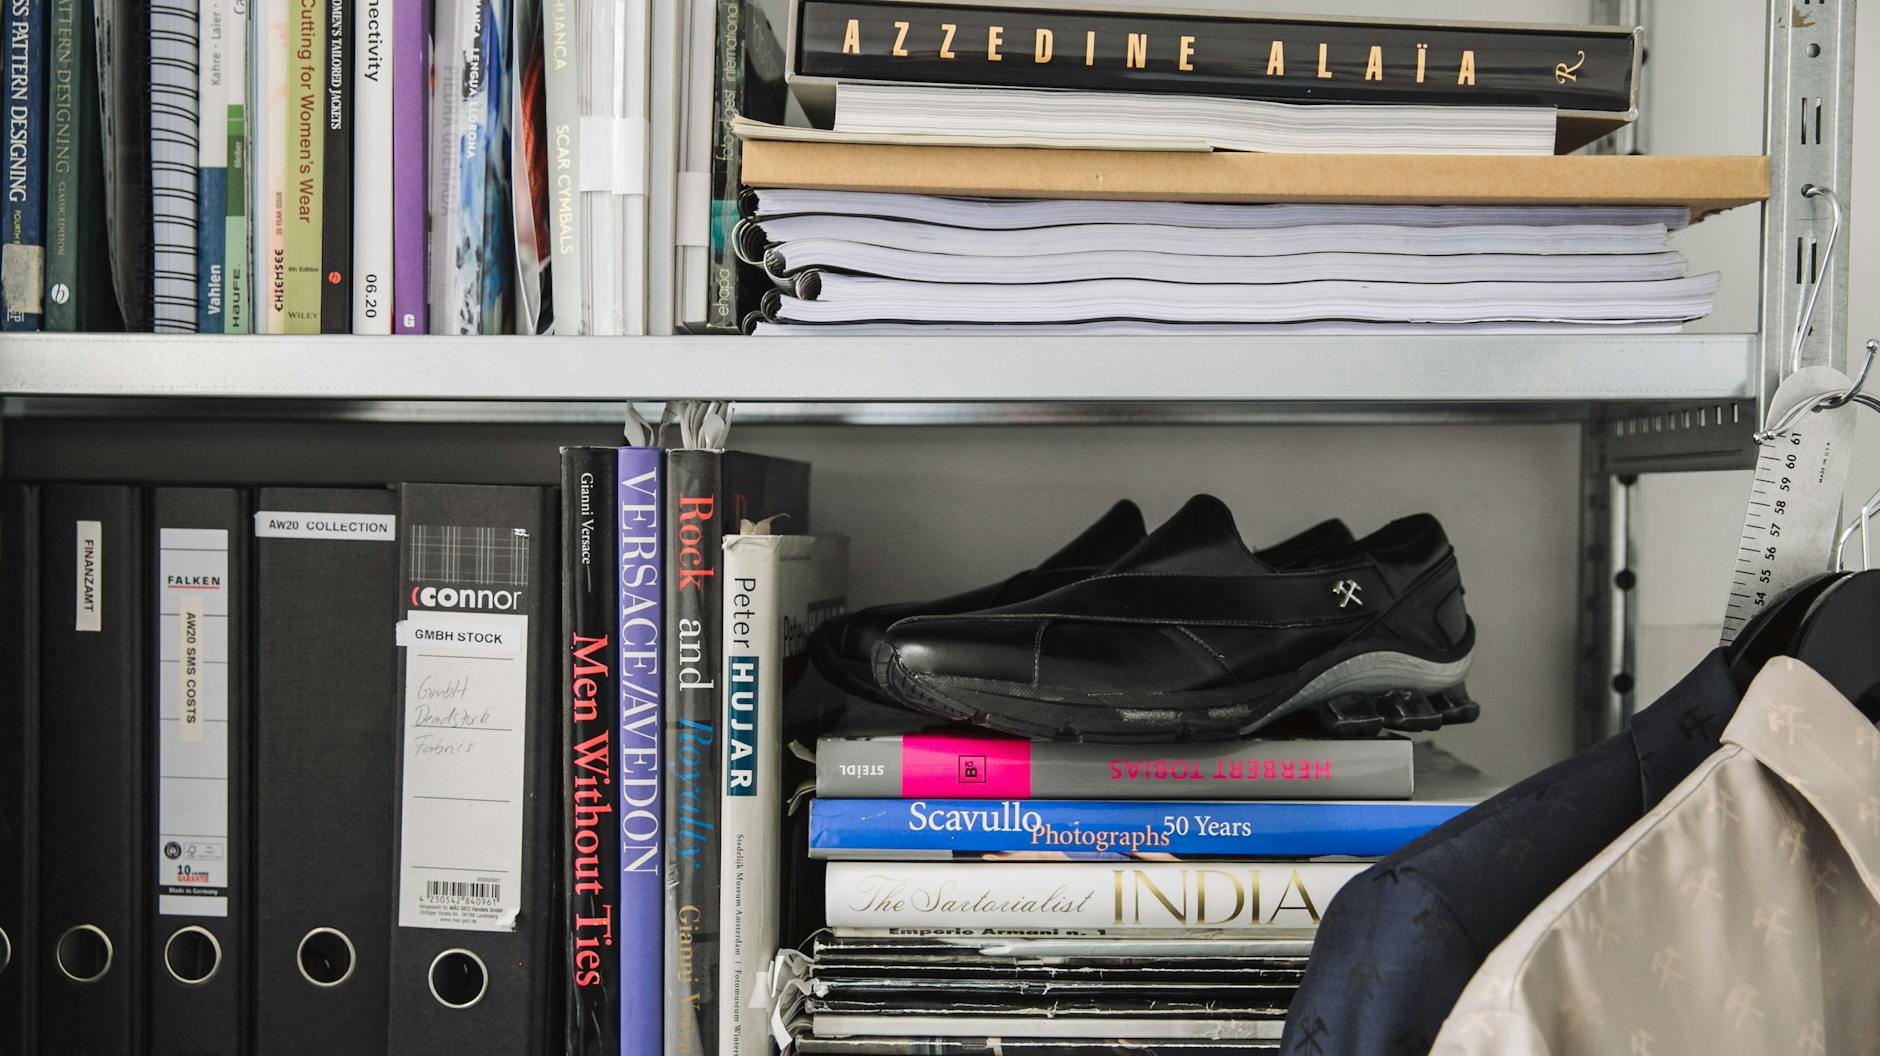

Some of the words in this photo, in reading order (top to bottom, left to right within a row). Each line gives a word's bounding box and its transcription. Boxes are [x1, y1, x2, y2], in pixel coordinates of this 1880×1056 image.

[211, 14, 221, 40] Laier
[297, 0, 315, 59] Cutting
[11, 22, 29, 100] PATTERN
[211, 52, 221, 86] Kahre
[331, 38, 342, 87] TAILORED
[468, 49, 480, 97] LENGUA
[842, 19, 1196, 72] AZZEDINE
[1266, 40, 1476, 86] ALAÏA
[301, 65, 315, 90] for
[55, 70, 72, 173] DESIGNING
[329, 88, 342, 130] JACKETS
[466, 101, 479, 159] LLORONA
[8, 106, 28, 202] DESIGNING
[299, 94, 315, 174] Women's
[556, 124, 571, 170] SCAR
[275, 191, 283, 208] ISSUE
[299, 178, 314, 223] Wear
[558, 174, 574, 254] CYMBALS
[57, 218, 65, 255] EDITION
[208, 264, 221, 315] Vahlen
[274, 249, 284, 311] CHIEMSEE
[365, 274, 377, 318] 06.20
[713, 269, 734, 316] ehapa
[288, 311, 318, 319] WILEY
[1790, 432, 1802, 445] 61
[1780, 476, 1791, 491] 59
[1786, 454, 1797, 469] 60
[581, 472, 593, 516] Gianni
[1774, 500, 1786, 515] 58
[269, 519, 299, 531] AW20
[306, 521, 388, 533] COLLECTION
[582, 517, 595, 565] Versace
[679, 495, 715, 591] Rock
[1769, 523, 1781, 537] 57
[84, 539, 94, 612] FINANZAMT
[1764, 546, 1777, 561] 56
[168, 575, 221, 586] FALKEN
[1759, 569, 1771, 584] 55
[734, 578, 756, 648] Peter
[1754, 592, 1766, 606] 54
[186, 611, 196, 644] AW20
[415, 629, 453, 641] GMBH
[457, 632, 503, 644] STOCK
[186, 647, 196, 676] SMS
[621, 467, 658, 876] VERSACE/AVEDON
[679, 618, 715, 691] and
[417, 675, 469, 699] GmbH
[573, 632, 609, 723] Men
[186, 679, 196, 724] COSTS
[731, 662, 754, 789] HUJAR
[1109, 758, 1200, 780] TOBIAS
[1213, 760, 1332, 780] HERBERT
[574, 729, 613, 895] Without
[909, 801, 1042, 833] Scavullo
[1031, 824, 1170, 852] Photographs
[1163, 816, 1189, 837] 50
[1194, 815, 1252, 837] Years
[177, 865, 191, 875] 10
[735, 833, 744, 869] Stedelijk
[430, 896, 461, 904] 250542
[465, 897, 497, 907] 840961
[735, 872, 744, 907] Museum
[848, 874, 904, 914] The
[910, 879, 1096, 914] Sartorialist
[1112, 869, 1322, 926] INDIA
[575, 904, 613, 987] Ties
[678, 905, 700, 983] Gianni
[734, 909, 743, 956] Amsterdam
[889, 927, 974, 936] Emporio
[733, 970, 742, 1022] Fotomuseum
